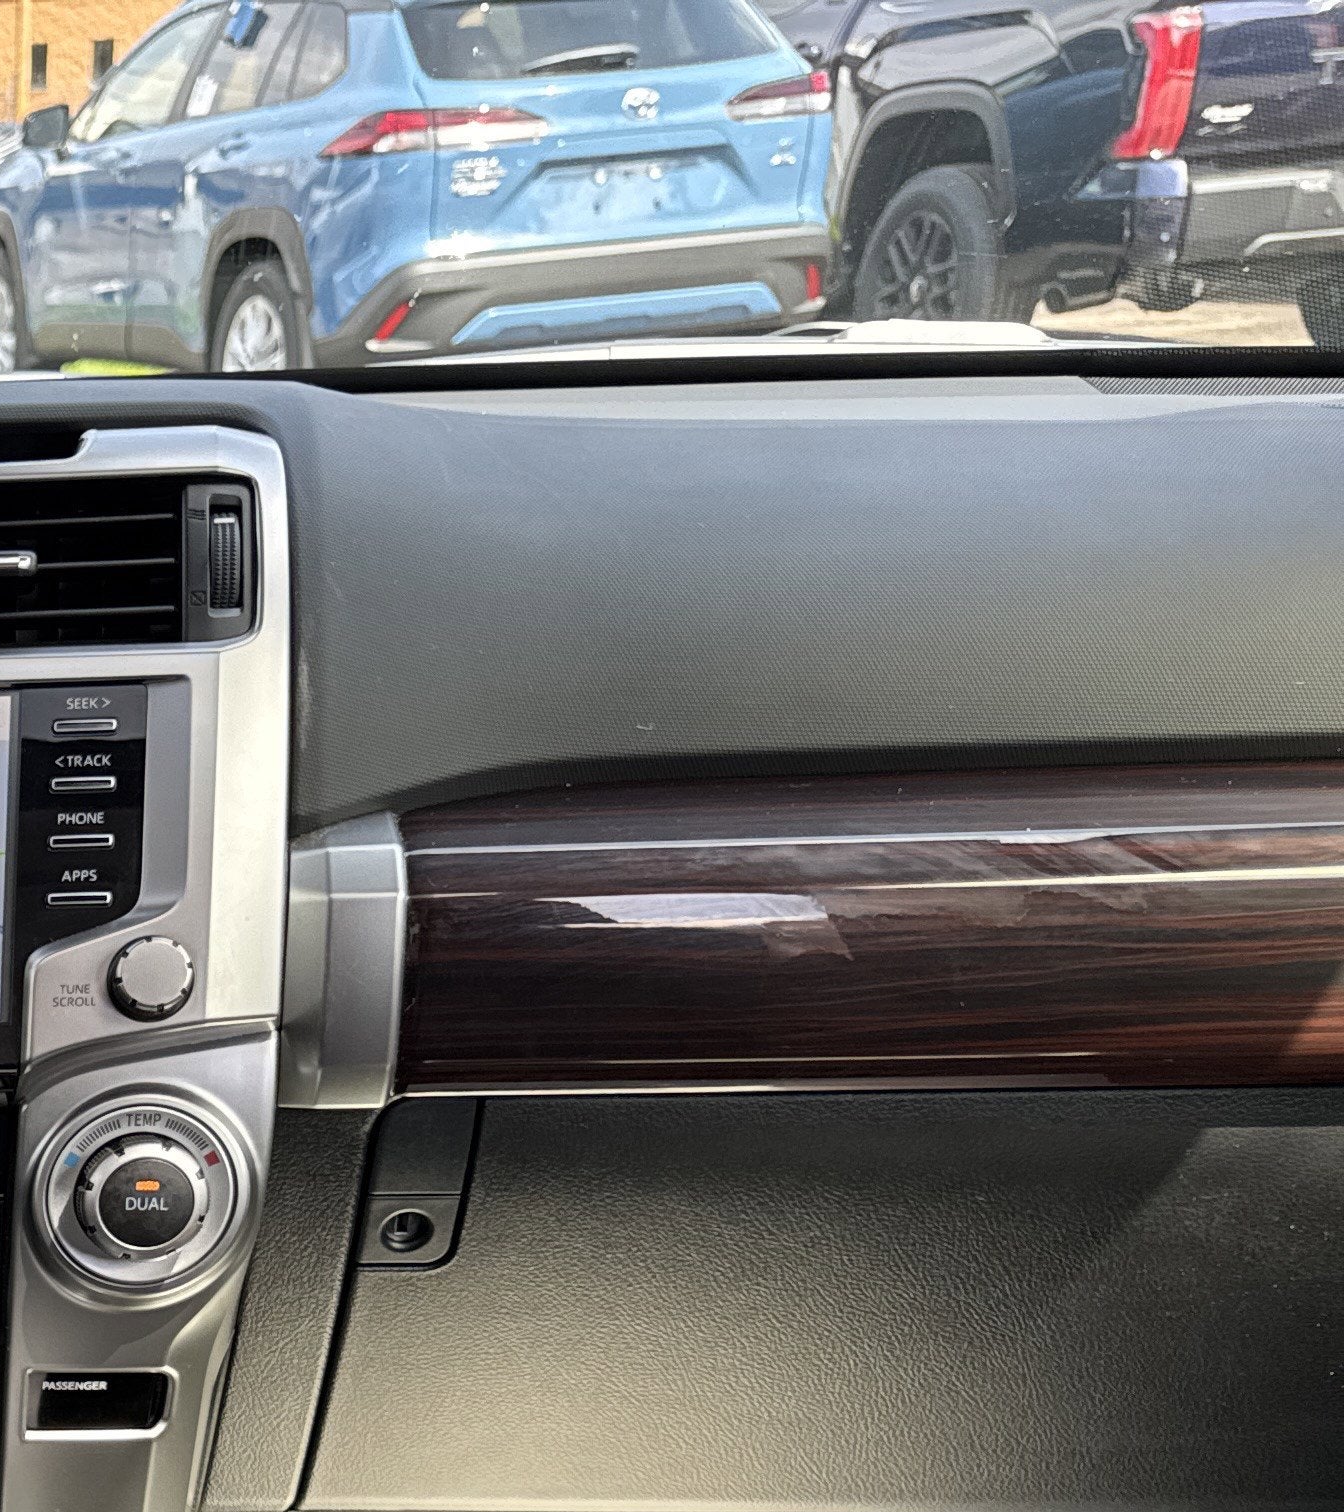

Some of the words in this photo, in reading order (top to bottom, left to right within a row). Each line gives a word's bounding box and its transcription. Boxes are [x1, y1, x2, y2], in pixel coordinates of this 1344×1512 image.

[66, 698, 97, 710] SEEK
[57, 811, 105, 825] PHONE
[62, 869, 98, 882] APPS
[60, 984, 91, 995] TUNE
[52, 996, 96, 1008] SCROLL
[126, 1113, 162, 1127] TEMP
[125, 1196, 169, 1211] DUAL
[41, 1381, 108, 1391] PASSENGER
